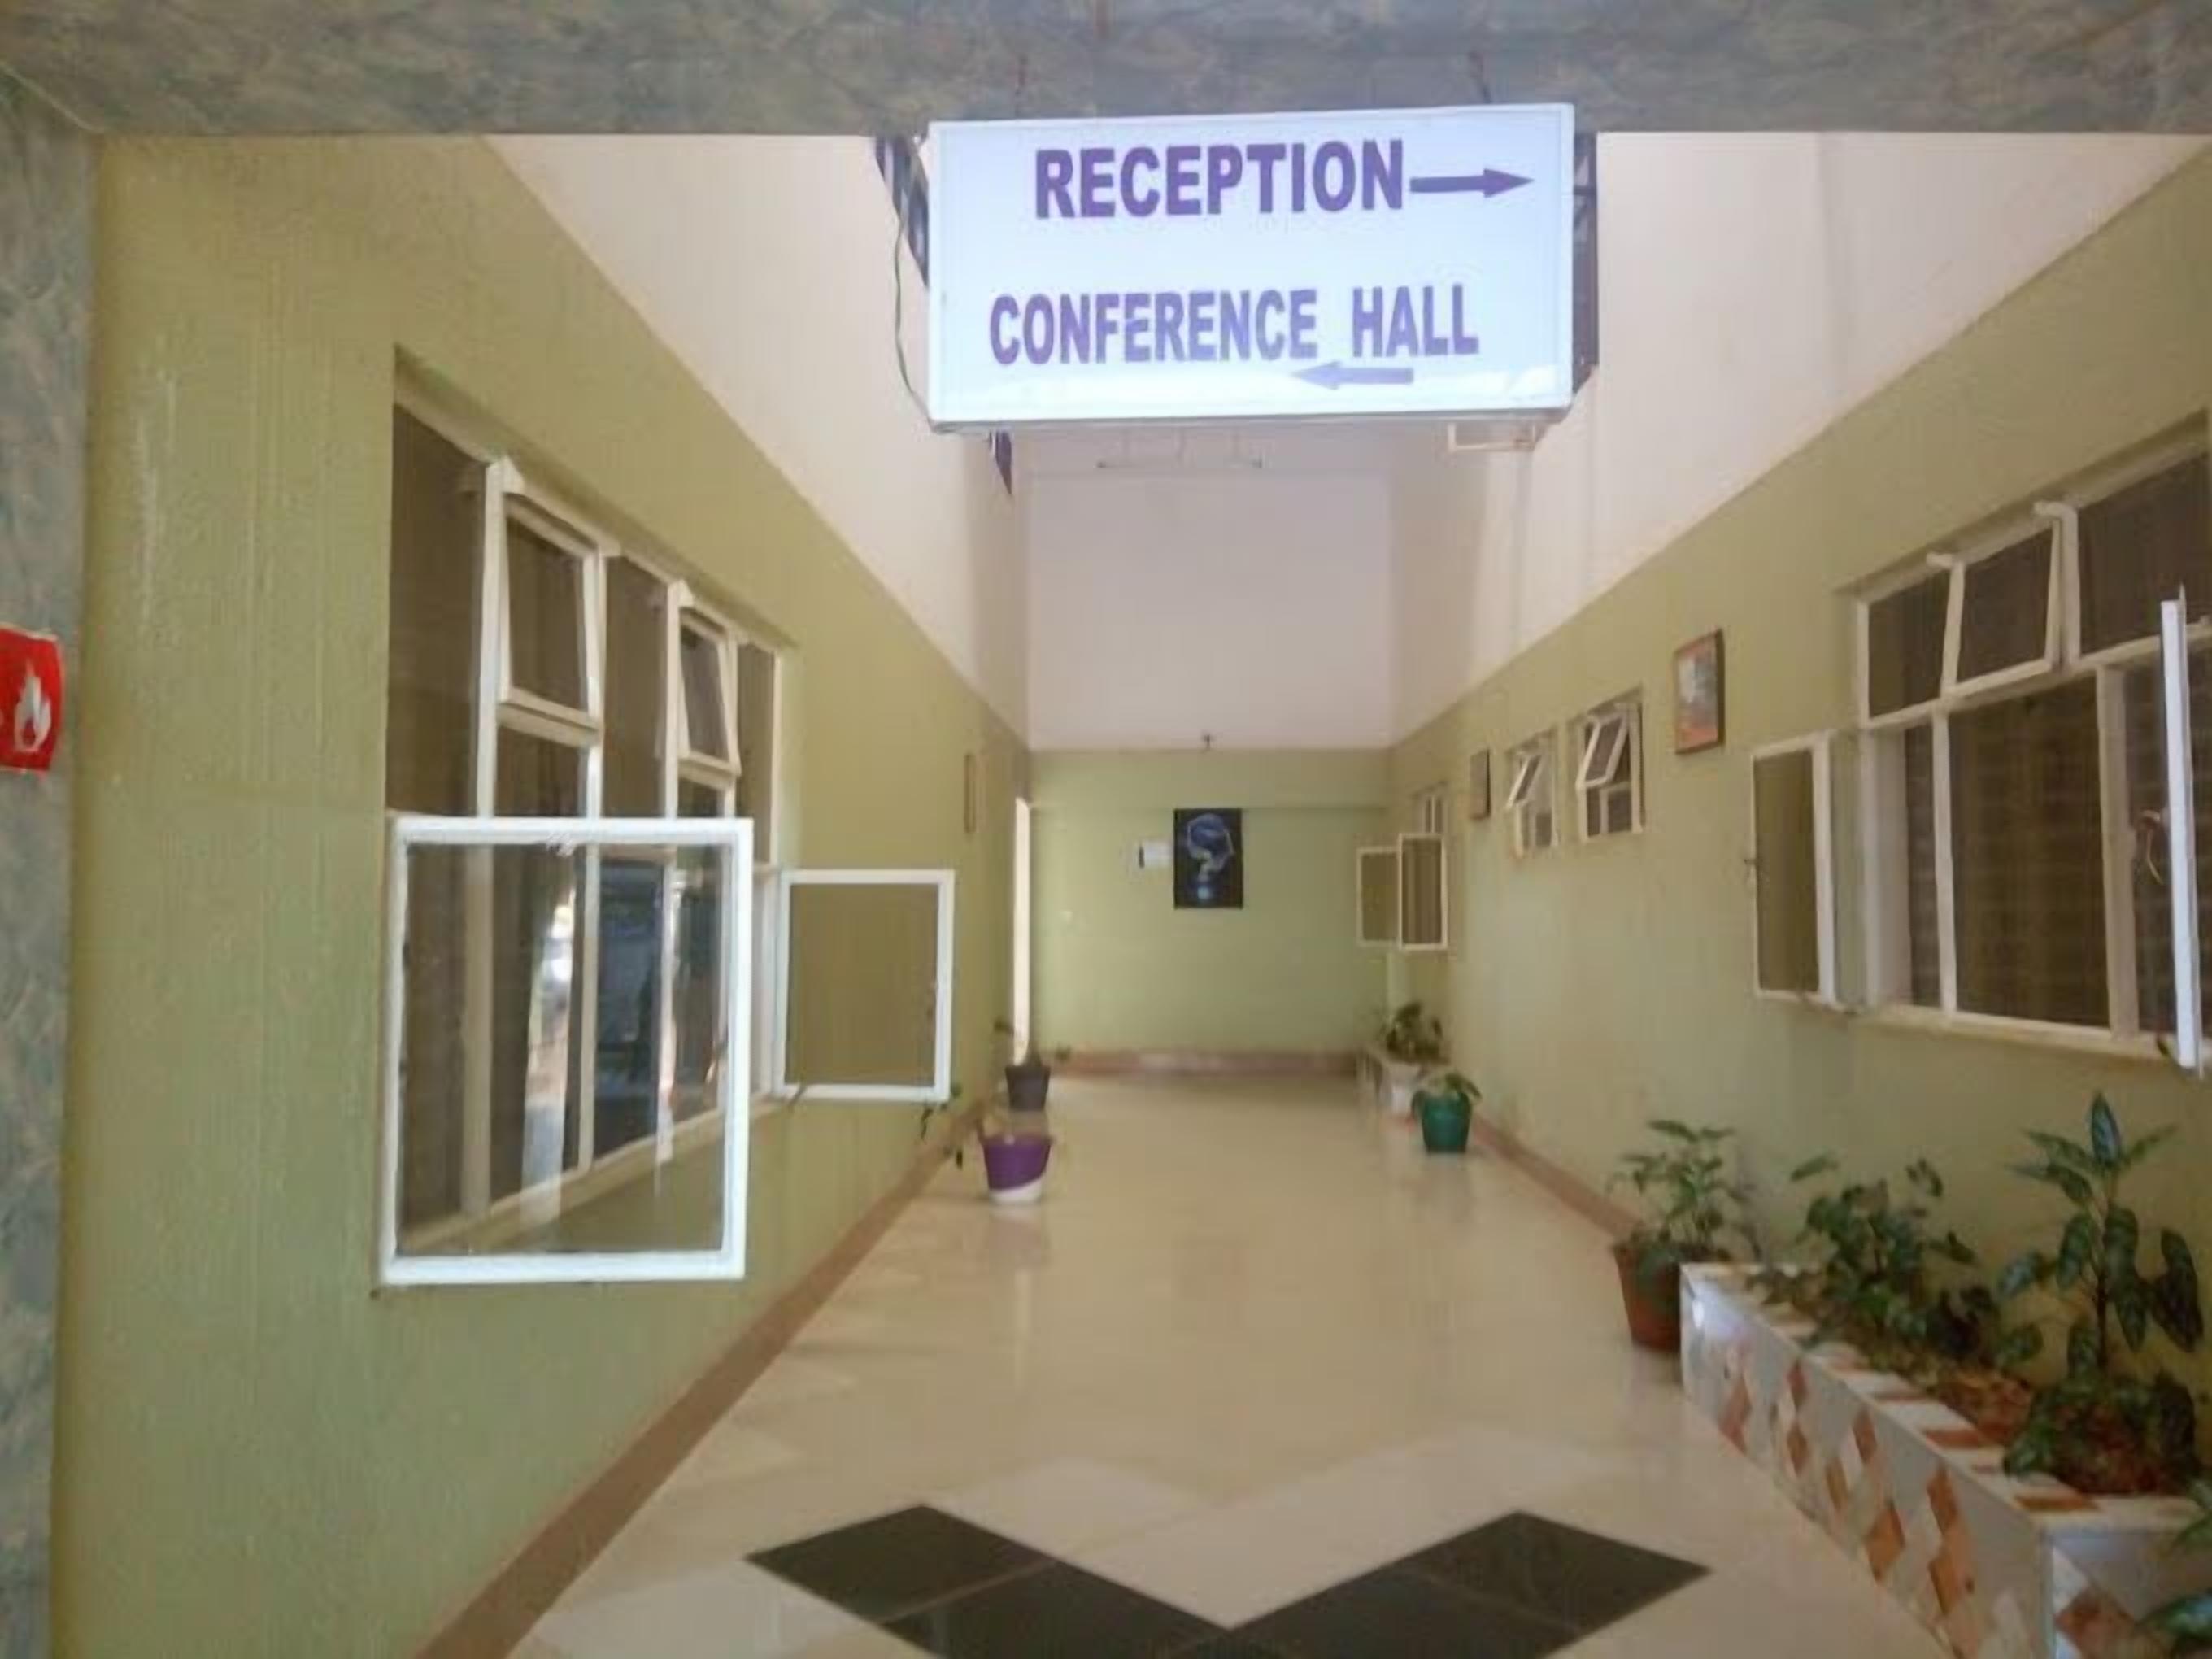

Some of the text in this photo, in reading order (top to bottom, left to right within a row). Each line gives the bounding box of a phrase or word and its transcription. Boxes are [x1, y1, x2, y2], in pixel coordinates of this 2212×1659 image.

[1034, 138, 1404, 219] RECEPTION
[989, 283, 1480, 366] CONFERENCE HALL
